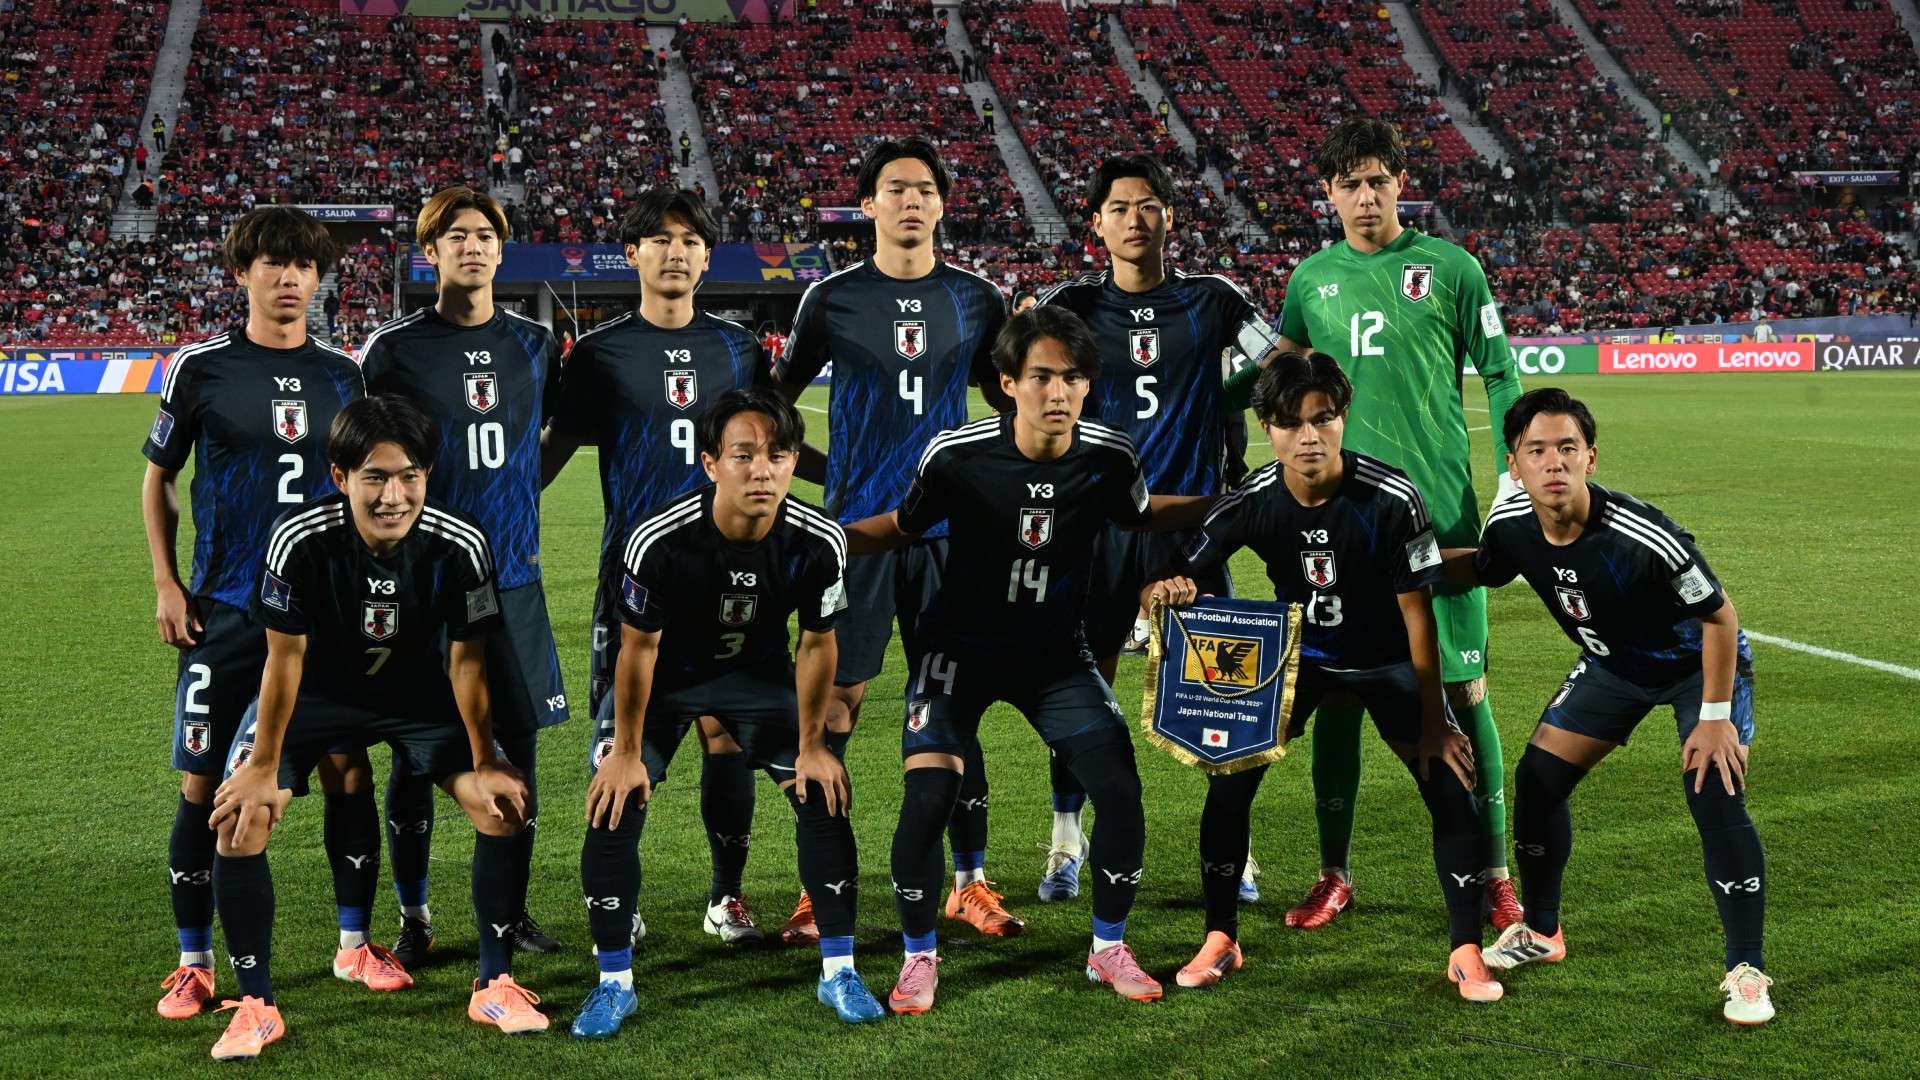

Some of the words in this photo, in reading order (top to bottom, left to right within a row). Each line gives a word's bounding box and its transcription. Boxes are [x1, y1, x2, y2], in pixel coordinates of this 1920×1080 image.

[1829, 175, 1844, 183] EXIT
[1851, 174, 1877, 182] SALIDA
[325, 209, 356, 217] SALIDA
[377, 209, 388, 217] 22
[1318, 283, 1338, 299] Y-3
[896, 299, 922, 313] Y-3
[1130, 308, 1154, 322] Y-3
[1350, 311, 1384, 357] 12
[464, 350, 491, 365] Y-3
[664, 349, 691, 363] Y-3
[1613, 349, 1697, 369] Lenovo
[1718, 348, 1801, 368] Lenovo
[1823, 345, 1904, 370] QATAR
[0, 362, 66, 392] ISA
[274, 376, 301, 392] Y-3
[899, 369, 922, 415] 4
[1136, 375, 1159, 419] 5
[467, 422, 505, 470] 10
[671, 419, 694, 465] 9
[278, 453, 303, 503] 2
[1026, 483, 1054, 499] Y-3
[1300, 529, 1329, 543] Y-3
[728, 570, 757, 587] Y-3
[1007, 559, 1050, 603] 14
[1552, 566, 1578, 583] Y-3
[367, 577, 396, 595] Y-3
[1307, 590, 1343, 627] 13
[1179, 611, 1196, 619] apan
[1198, 612, 1230, 623] Football
[1232, 616, 1278, 627] Association
[714, 632, 745, 660] 3
[1577, 627, 1610, 657] 6
[364, 647, 391, 675] 7
[1460, 650, 1480, 664] Y-3
[916, 652, 958, 696] 14
[185, 663, 211, 714] 2
[546, 695, 566, 712] Y-3
[1177, 706, 1202, 717] Japan
[1203, 708, 1235, 720] National
[1237, 712, 1257, 723] Team
[170, 867, 210, 885] Y-3
[1102, 868, 1143, 885] Y-3
[1715, 877, 1760, 895] Y-3
